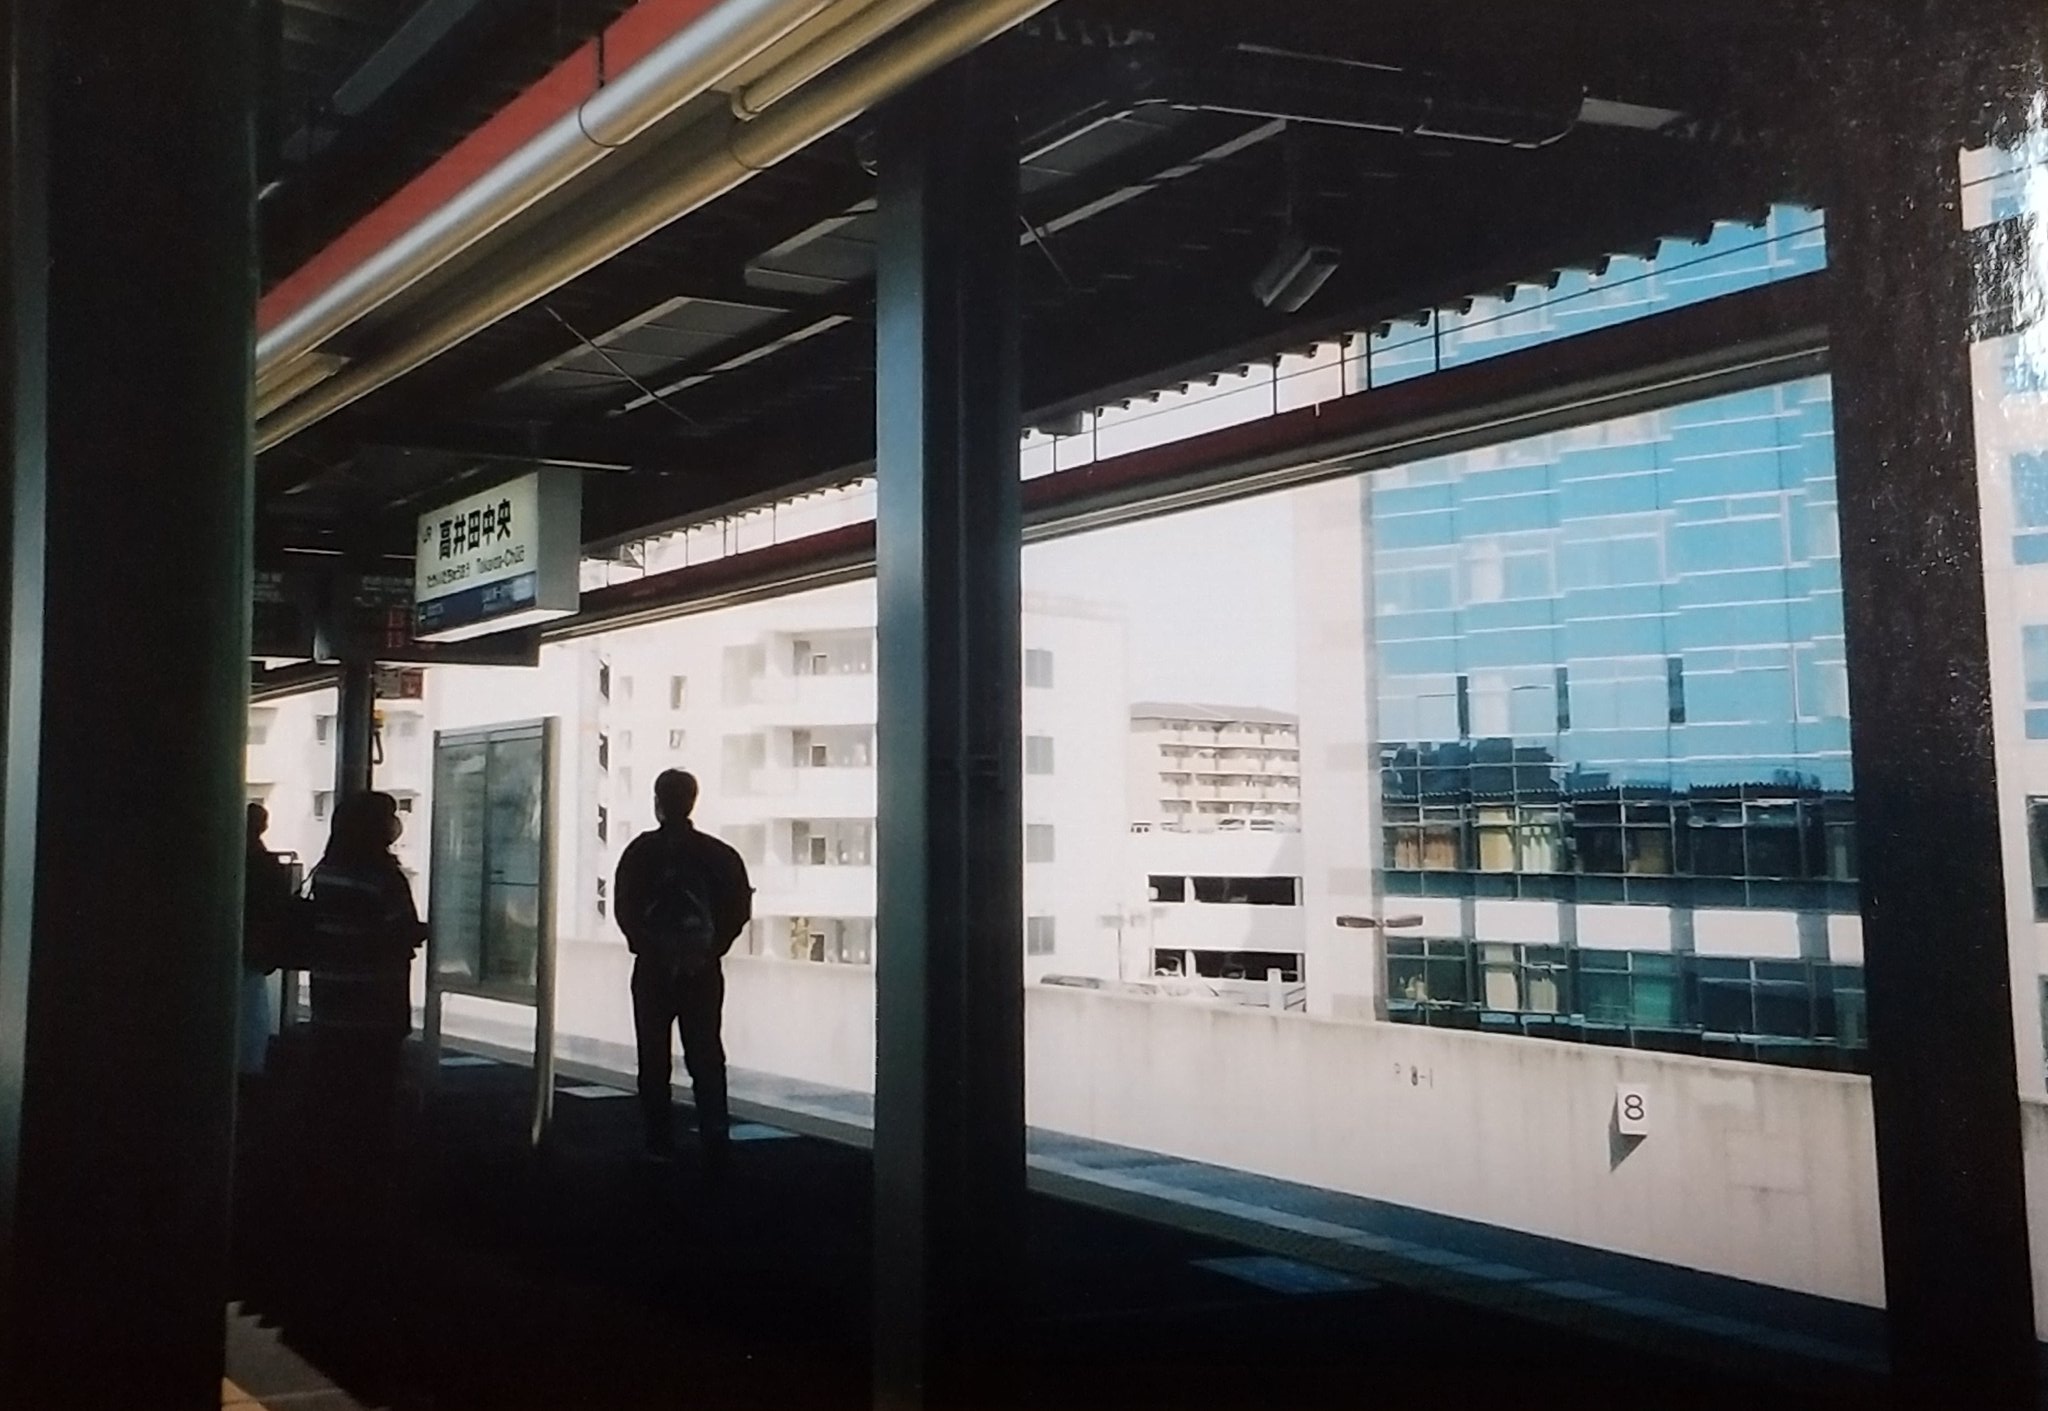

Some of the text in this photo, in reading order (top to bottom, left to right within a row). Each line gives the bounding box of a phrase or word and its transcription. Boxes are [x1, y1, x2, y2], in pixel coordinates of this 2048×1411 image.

[438, 498, 512, 561] 高井田中央
[1624, 1094, 1645, 1121] 8
